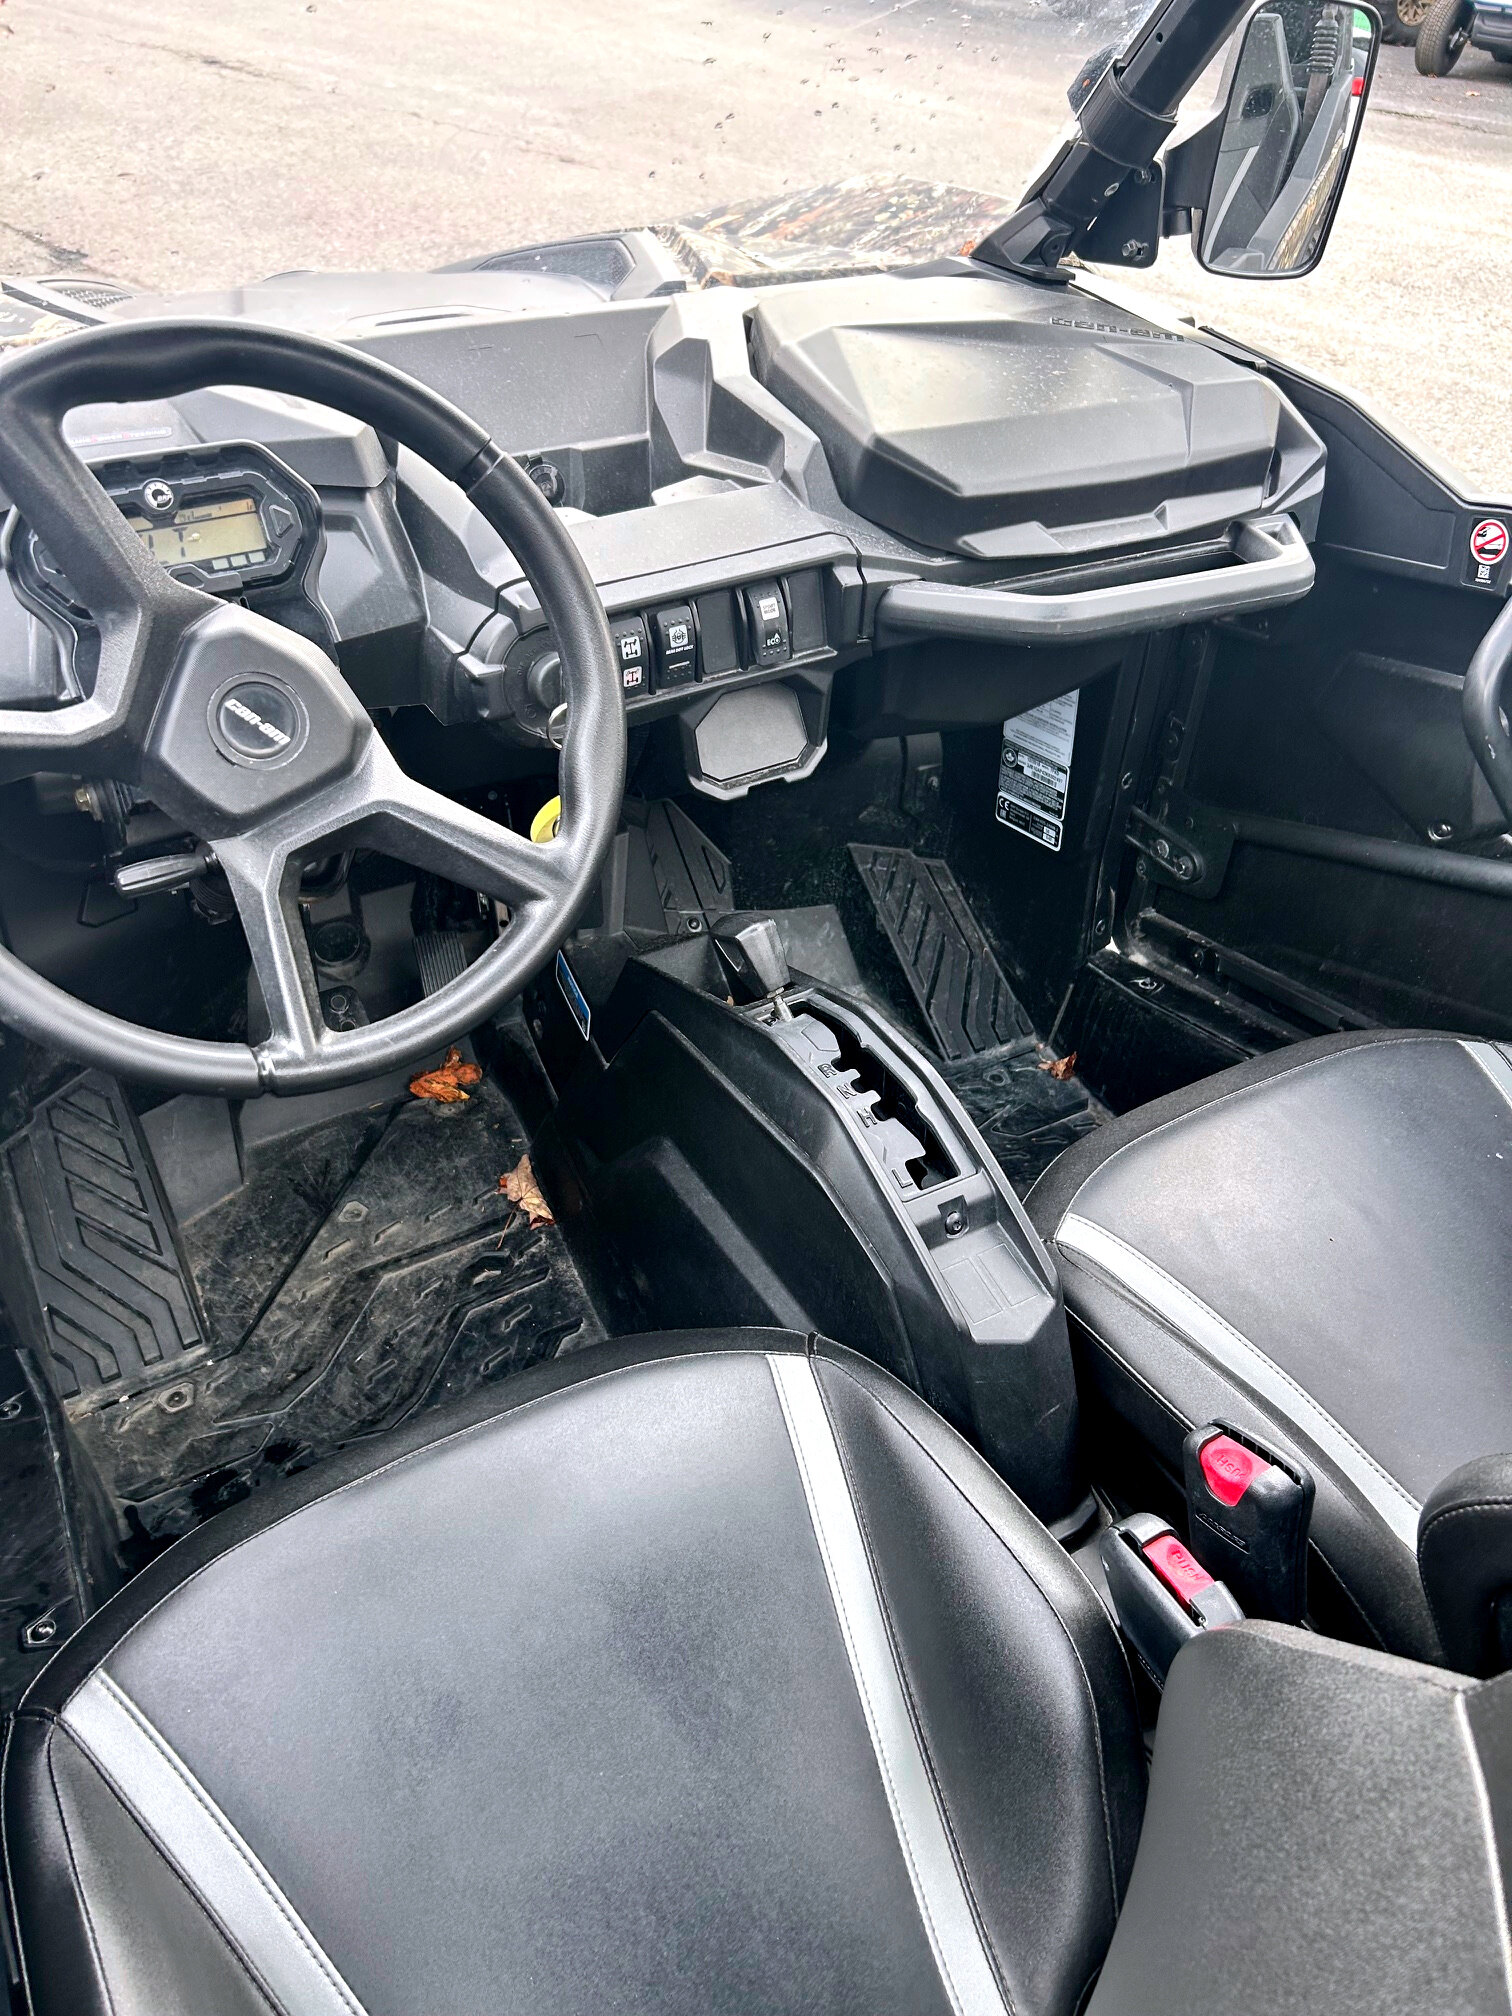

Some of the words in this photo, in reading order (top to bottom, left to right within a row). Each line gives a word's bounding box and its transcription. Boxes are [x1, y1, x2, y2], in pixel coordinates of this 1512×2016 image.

[224, 698, 291, 745] can-am
[818, 1063, 837, 1079] R
[836, 1083, 858, 1099] N
[856, 1108, 878, 1128] H
[891, 1168, 914, 1189] L
[1171, 1550, 1203, 1580] PUSH
